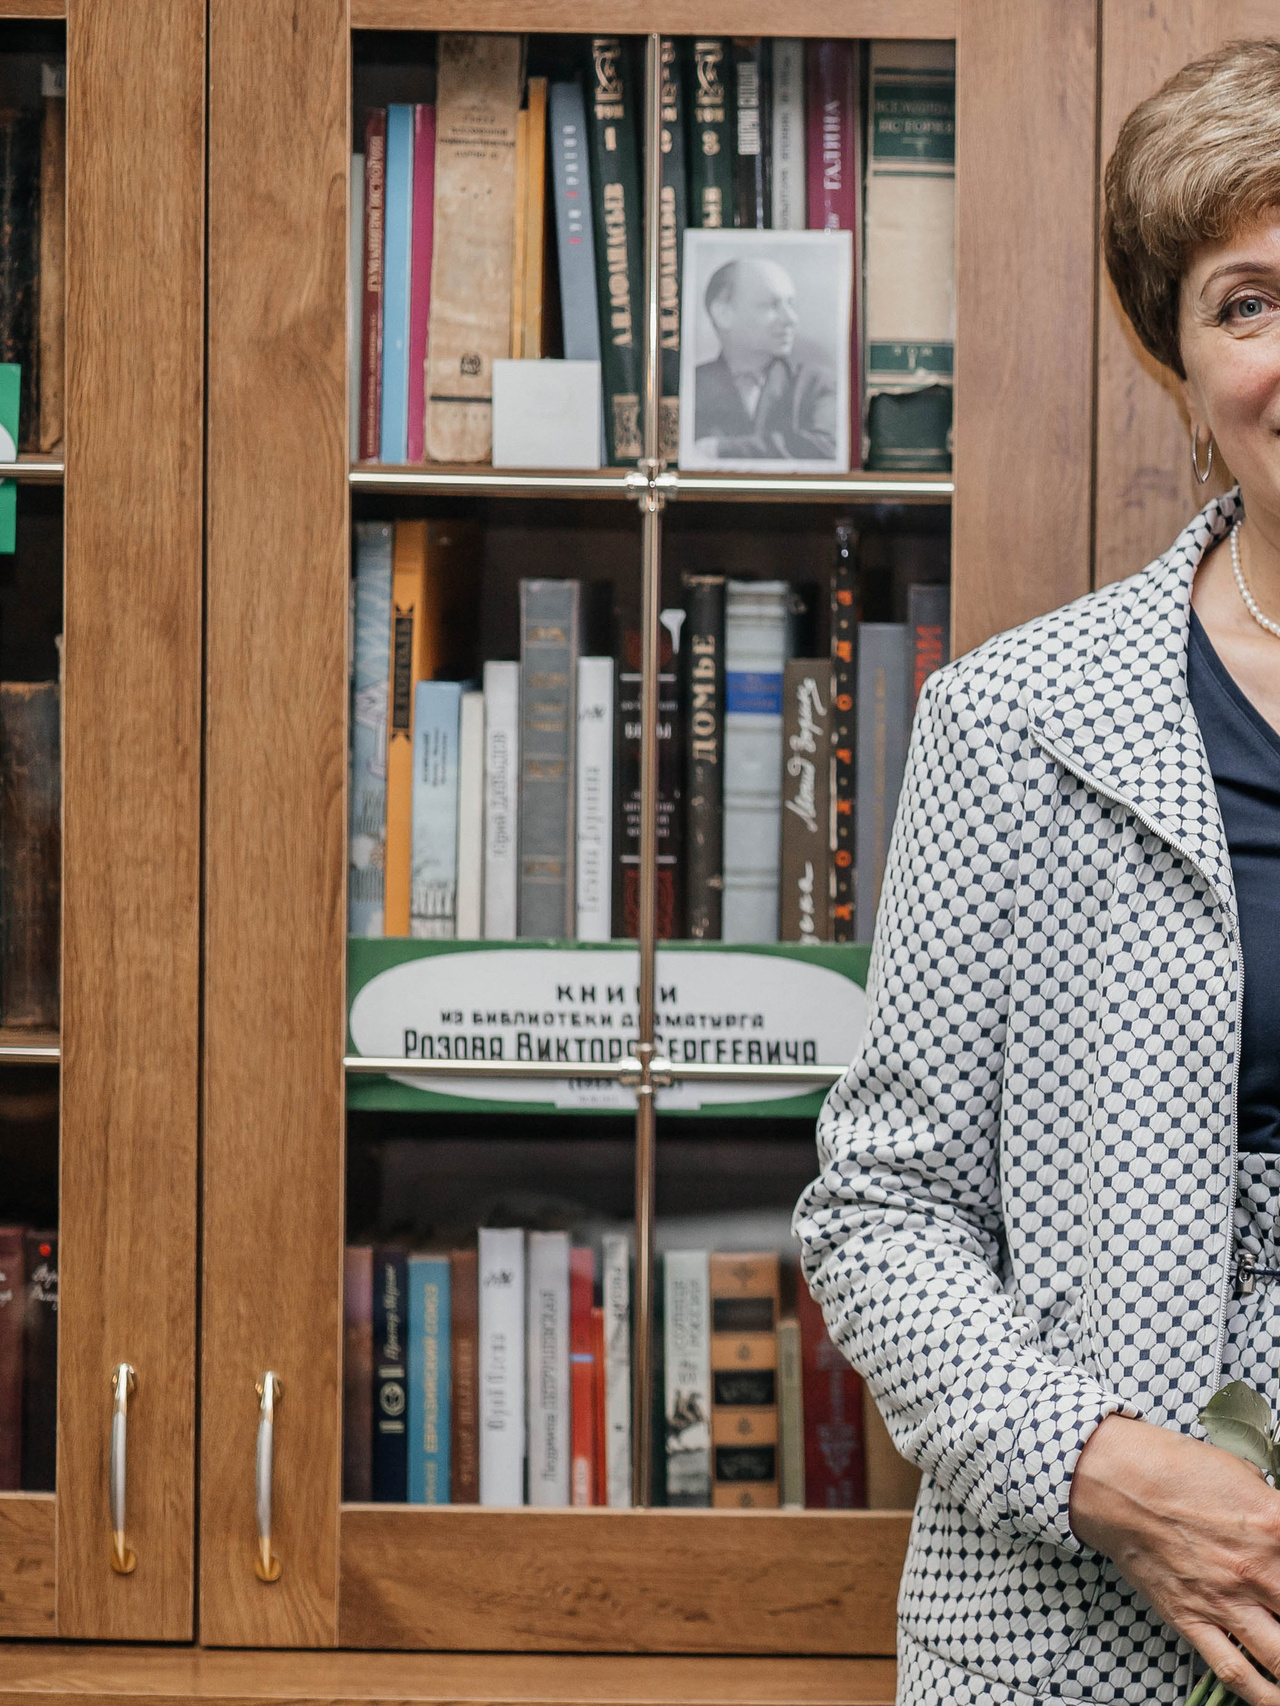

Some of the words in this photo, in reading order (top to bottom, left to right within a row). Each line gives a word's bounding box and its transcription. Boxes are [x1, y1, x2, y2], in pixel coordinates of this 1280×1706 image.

[822, 99, 841, 190] ГАЛИНА
[692, 634, 716, 764] ДОМЬЕ
[441, 1011, 463, 1024] ИЗ
[473, 1011, 613, 1027] БИБЛИОТЕКИ
[621, 1012, 764, 1029] ДАМАТУРГА
[556, 985, 677, 1004] КНИИ
